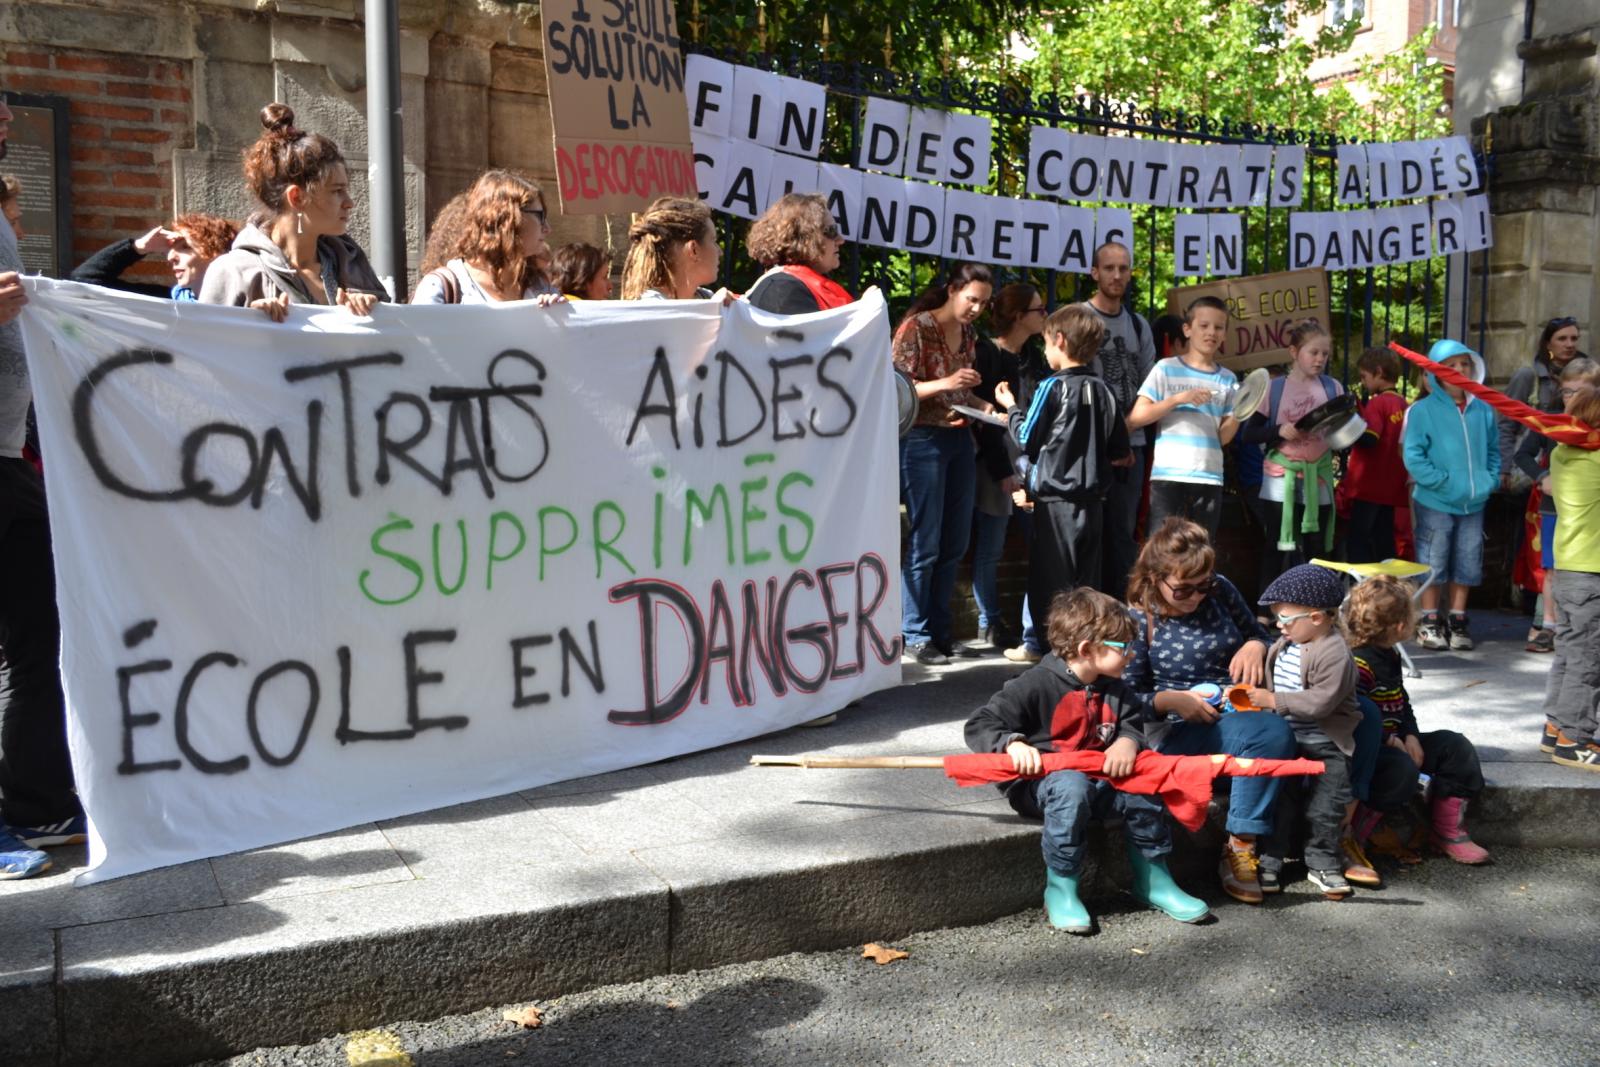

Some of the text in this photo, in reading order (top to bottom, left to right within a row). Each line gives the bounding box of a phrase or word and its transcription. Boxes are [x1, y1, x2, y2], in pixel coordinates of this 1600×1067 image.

[548, 20, 683, 92] SOLUTION
[608, 85, 651, 129] LA
[694, 81, 1472, 204] FIN DES CONTRATS AIDÉS
[557, 143, 697, 201] DEROGATION
[1184, 235, 1238, 271] EN
[1259, 285, 1320, 317] ECOLE
[1235, 317, 1320, 356] DANG
[73, 348, 550, 522] CONTRATS
[117, 551, 901, 775] ÉCOLE EN DANGER
